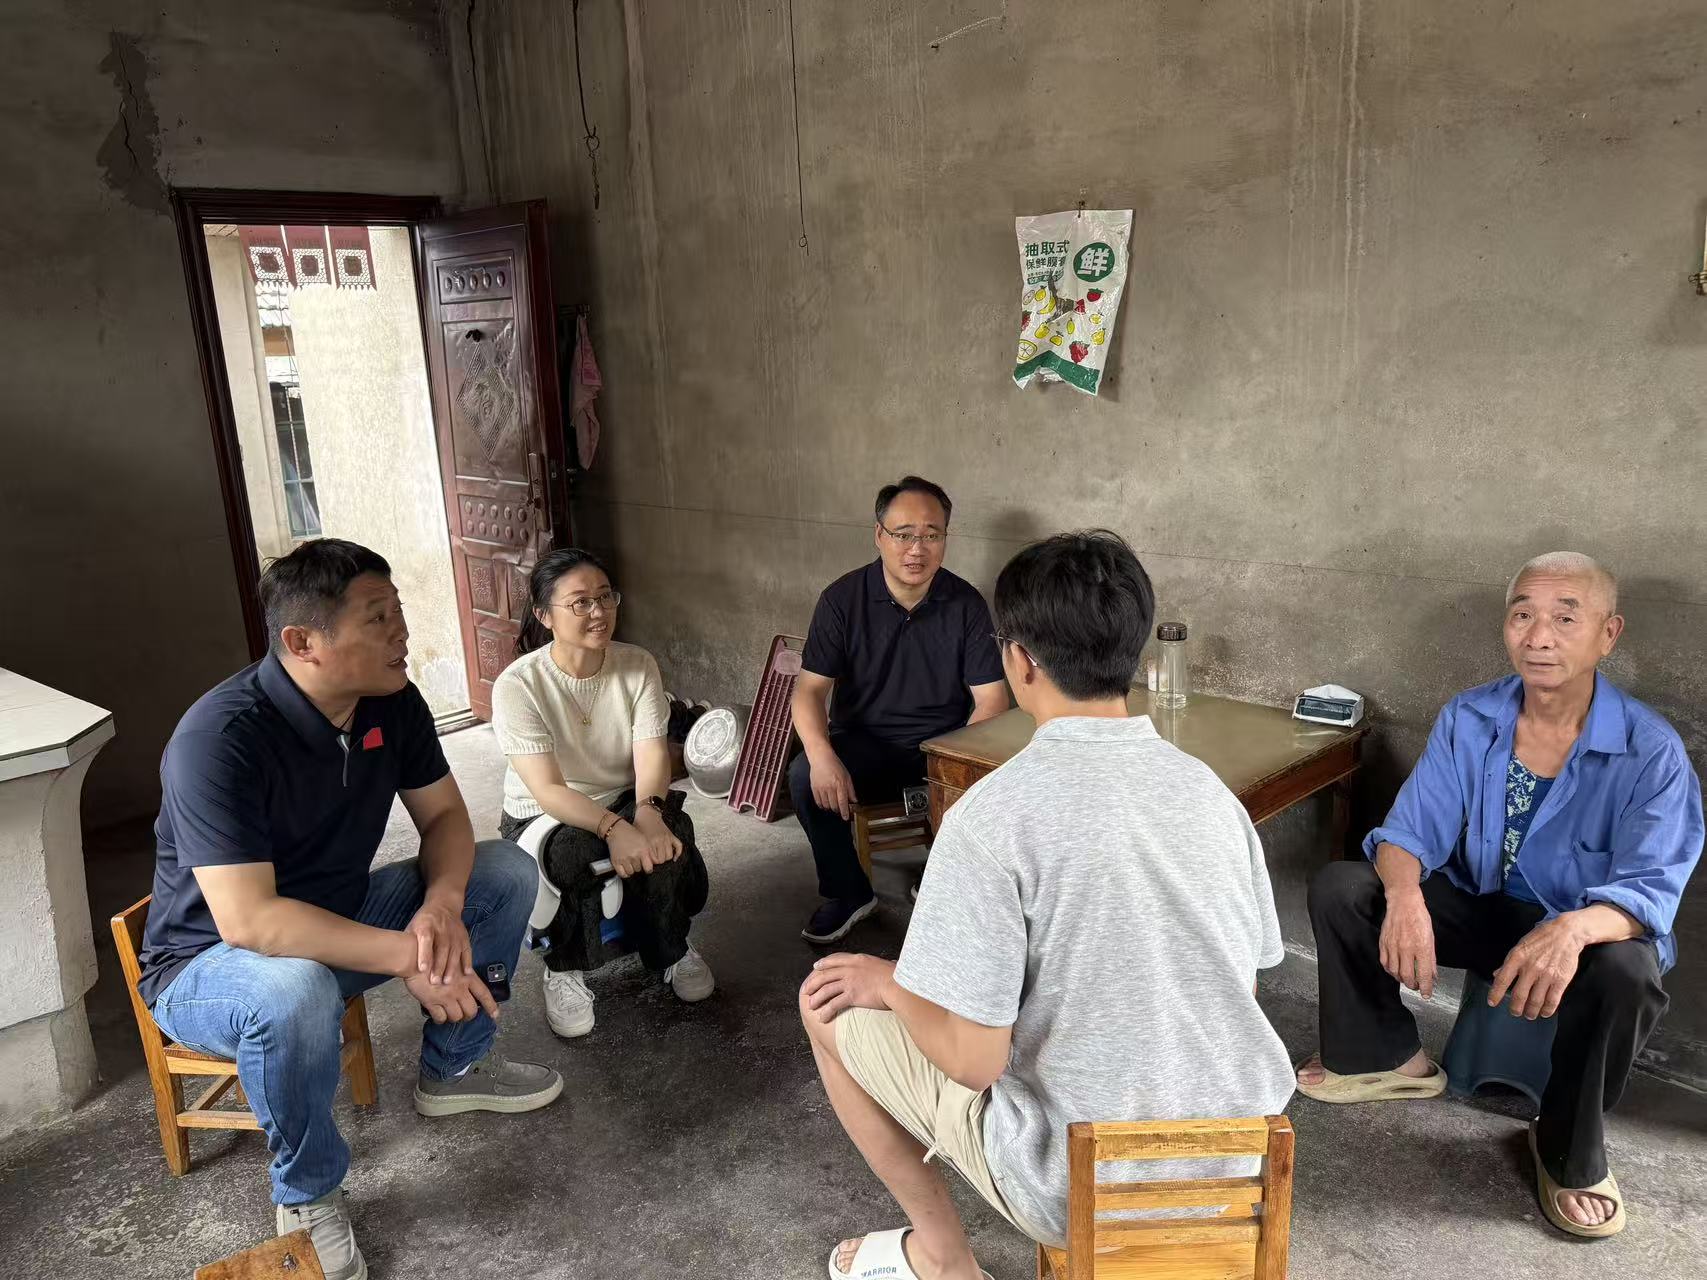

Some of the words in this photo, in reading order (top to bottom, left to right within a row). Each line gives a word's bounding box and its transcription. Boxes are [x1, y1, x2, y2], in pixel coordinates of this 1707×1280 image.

[1025, 240, 1069, 257] 抽取式
[1077, 248, 1110, 276] 鲜
